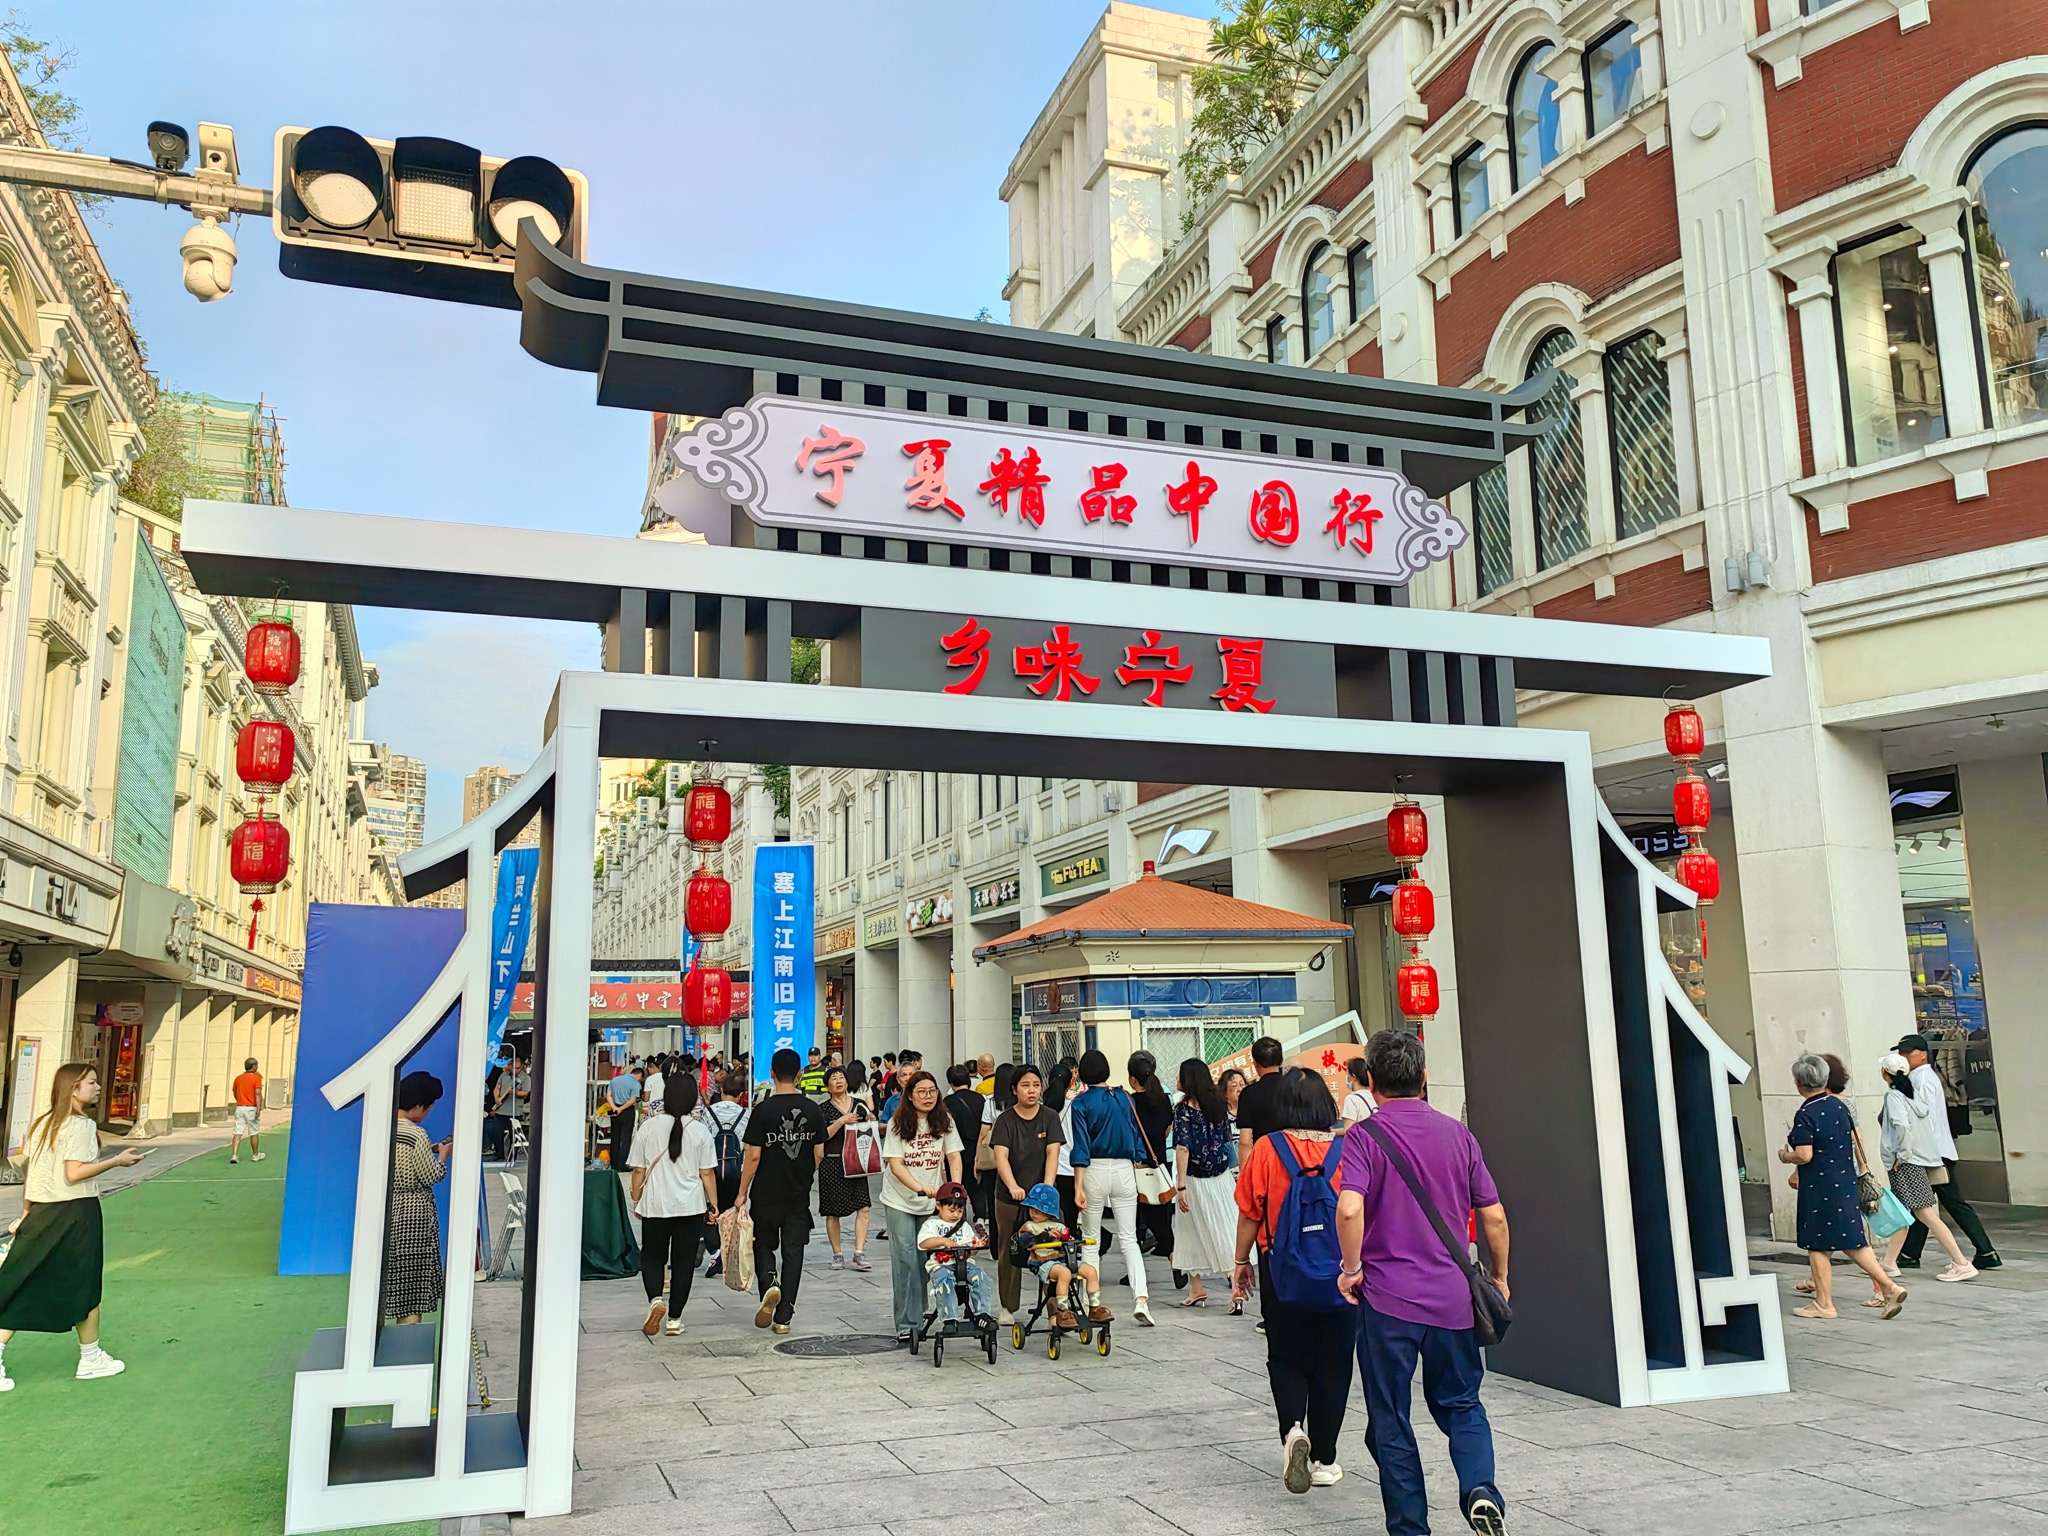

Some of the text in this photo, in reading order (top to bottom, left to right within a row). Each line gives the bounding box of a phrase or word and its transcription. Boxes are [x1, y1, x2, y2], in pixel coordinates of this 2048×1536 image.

[796, 423, 1385, 558] 宁夏精品中国行
[940, 617, 1277, 714] 乡味宁夏
[1075, 856, 1099, 878] TEA
[1060, 993, 1076, 1004] POLICE
